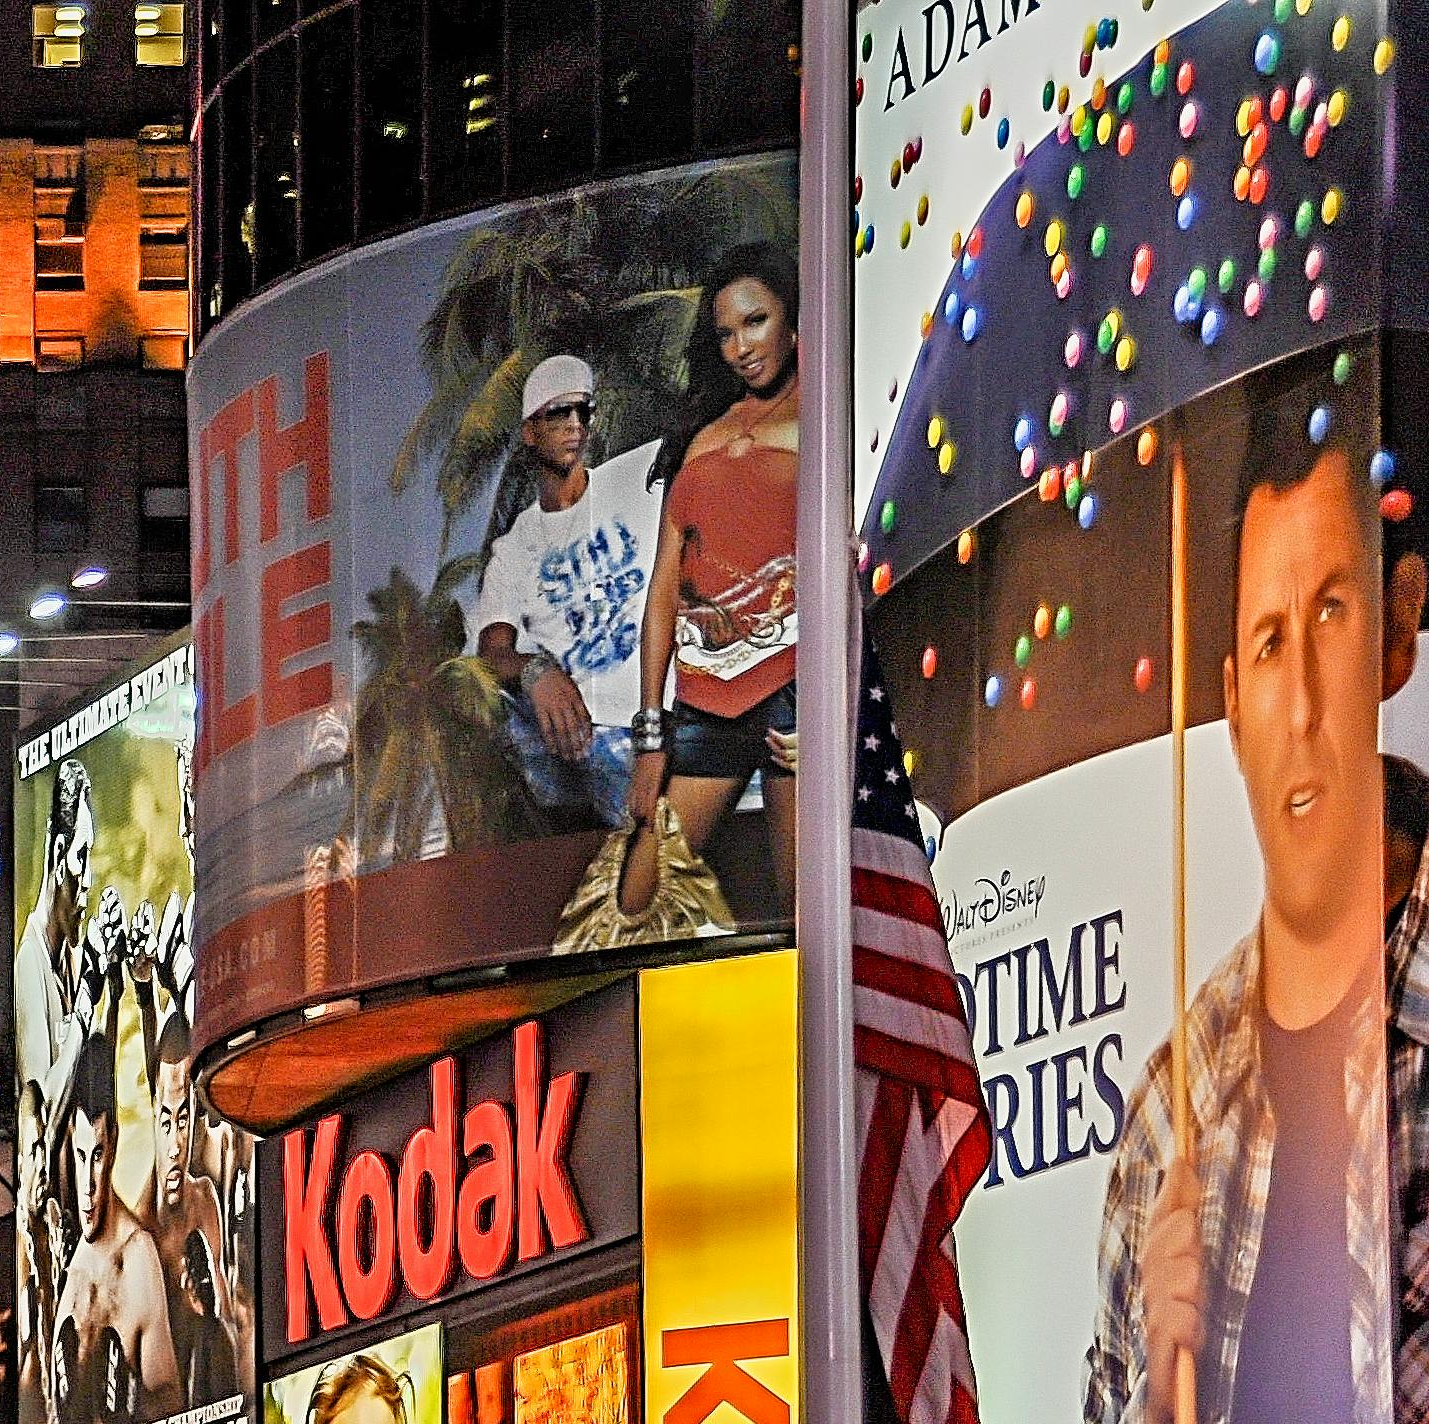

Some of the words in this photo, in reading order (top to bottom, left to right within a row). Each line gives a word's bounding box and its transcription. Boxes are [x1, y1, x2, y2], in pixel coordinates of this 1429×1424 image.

[18, 731, 51, 780] THE
[51, 681, 131, 762] ULTIMATE
[130, 646, 188, 715] EVENT
[973, 913, 1127, 1055] TIME
[284, 1020, 591, 1344] Kodak
[979, 1033, 1125, 1185] RIES
